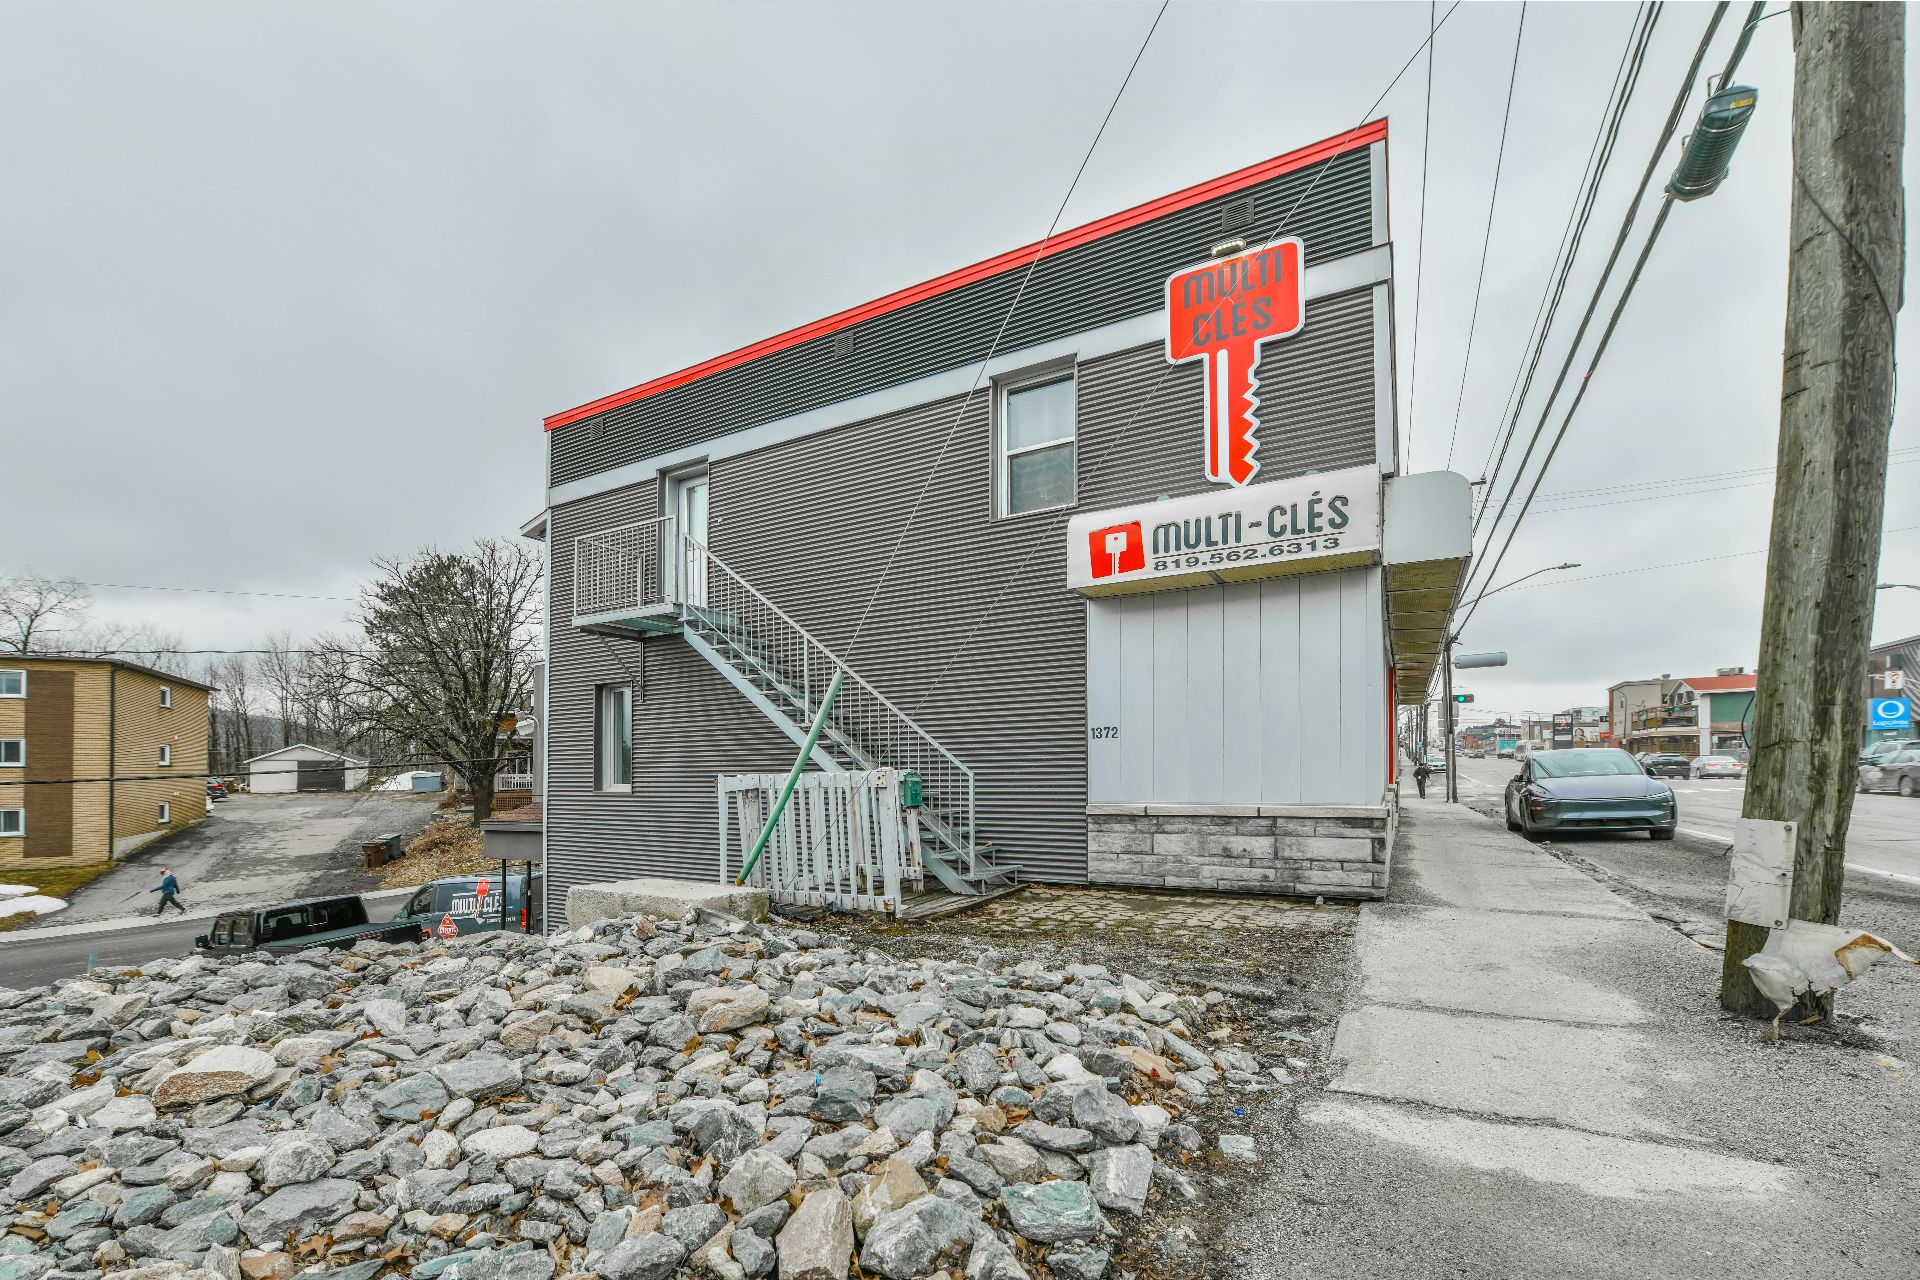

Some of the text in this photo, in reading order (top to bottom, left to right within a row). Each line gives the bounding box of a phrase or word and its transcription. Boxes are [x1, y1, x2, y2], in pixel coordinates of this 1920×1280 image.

[1183, 250, 1282, 309] MULTI
[1192, 295, 1272, 346] CLÉS
[1153, 537, 1340, 572] 819.562.6313
[1091, 726, 1119, 739] 1372
[450, 897, 477, 914] MULTI
